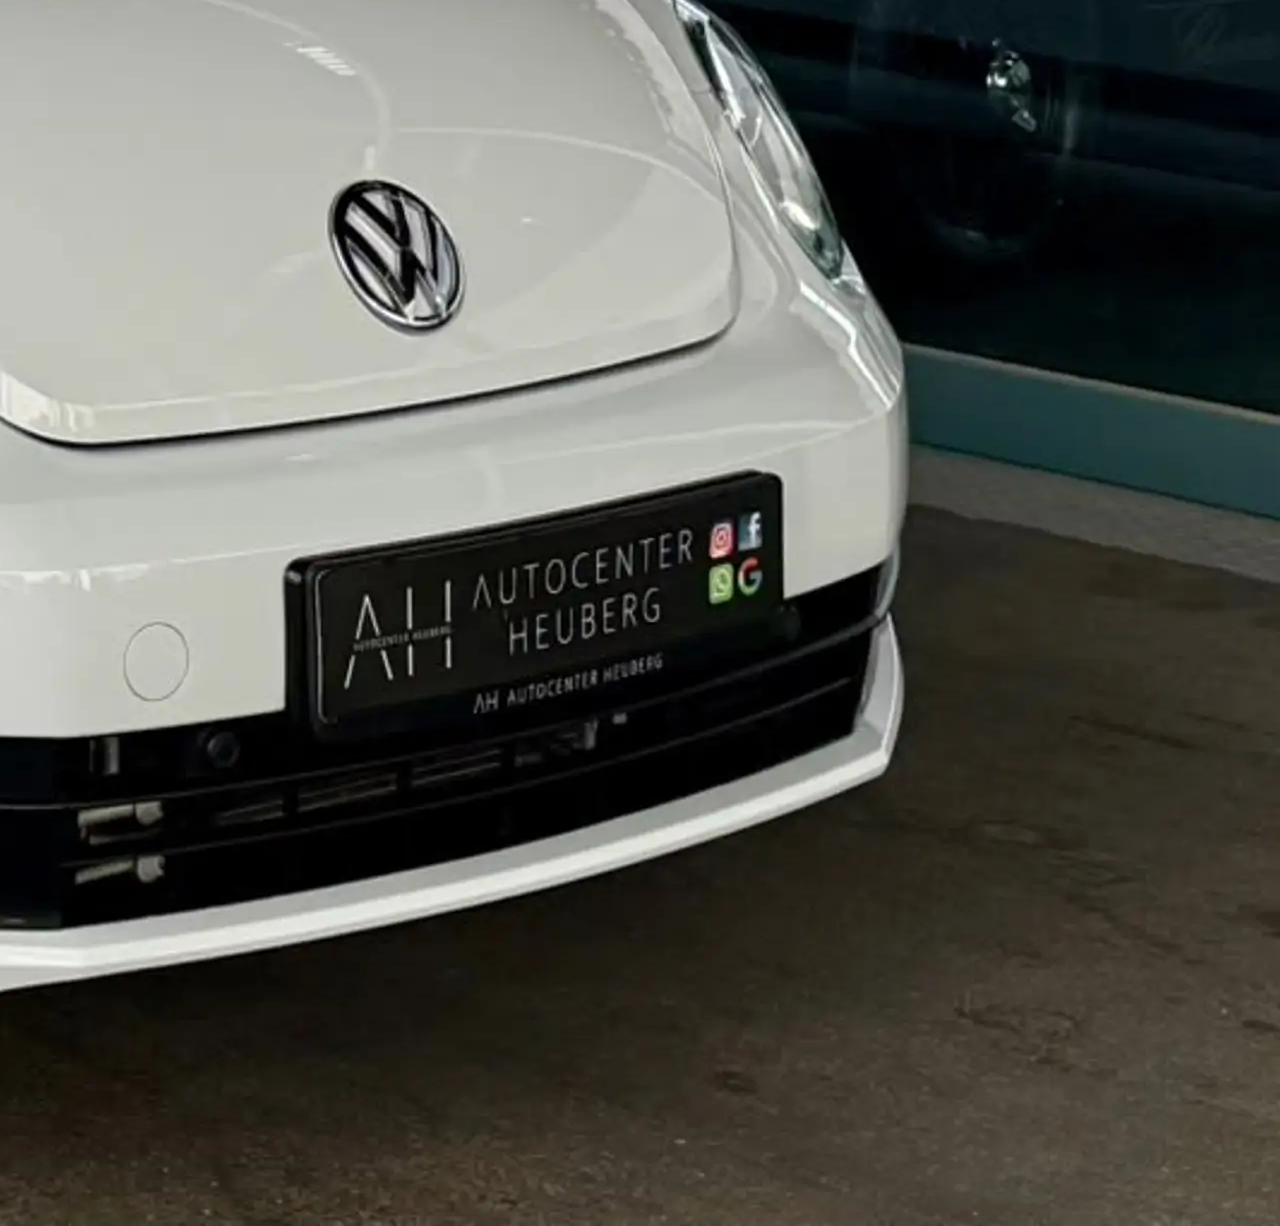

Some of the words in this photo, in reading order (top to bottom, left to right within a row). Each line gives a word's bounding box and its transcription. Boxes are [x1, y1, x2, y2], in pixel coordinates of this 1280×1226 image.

[472, 529, 694, 610] AUTOCENTER
[344, 580, 452, 691] AH
[509, 587, 661, 656] HEUBERG
[473, 688, 499, 714] AH
[506, 669, 598, 707] AUTOCENTER
[603, 652, 664, 683] HEUBERG
